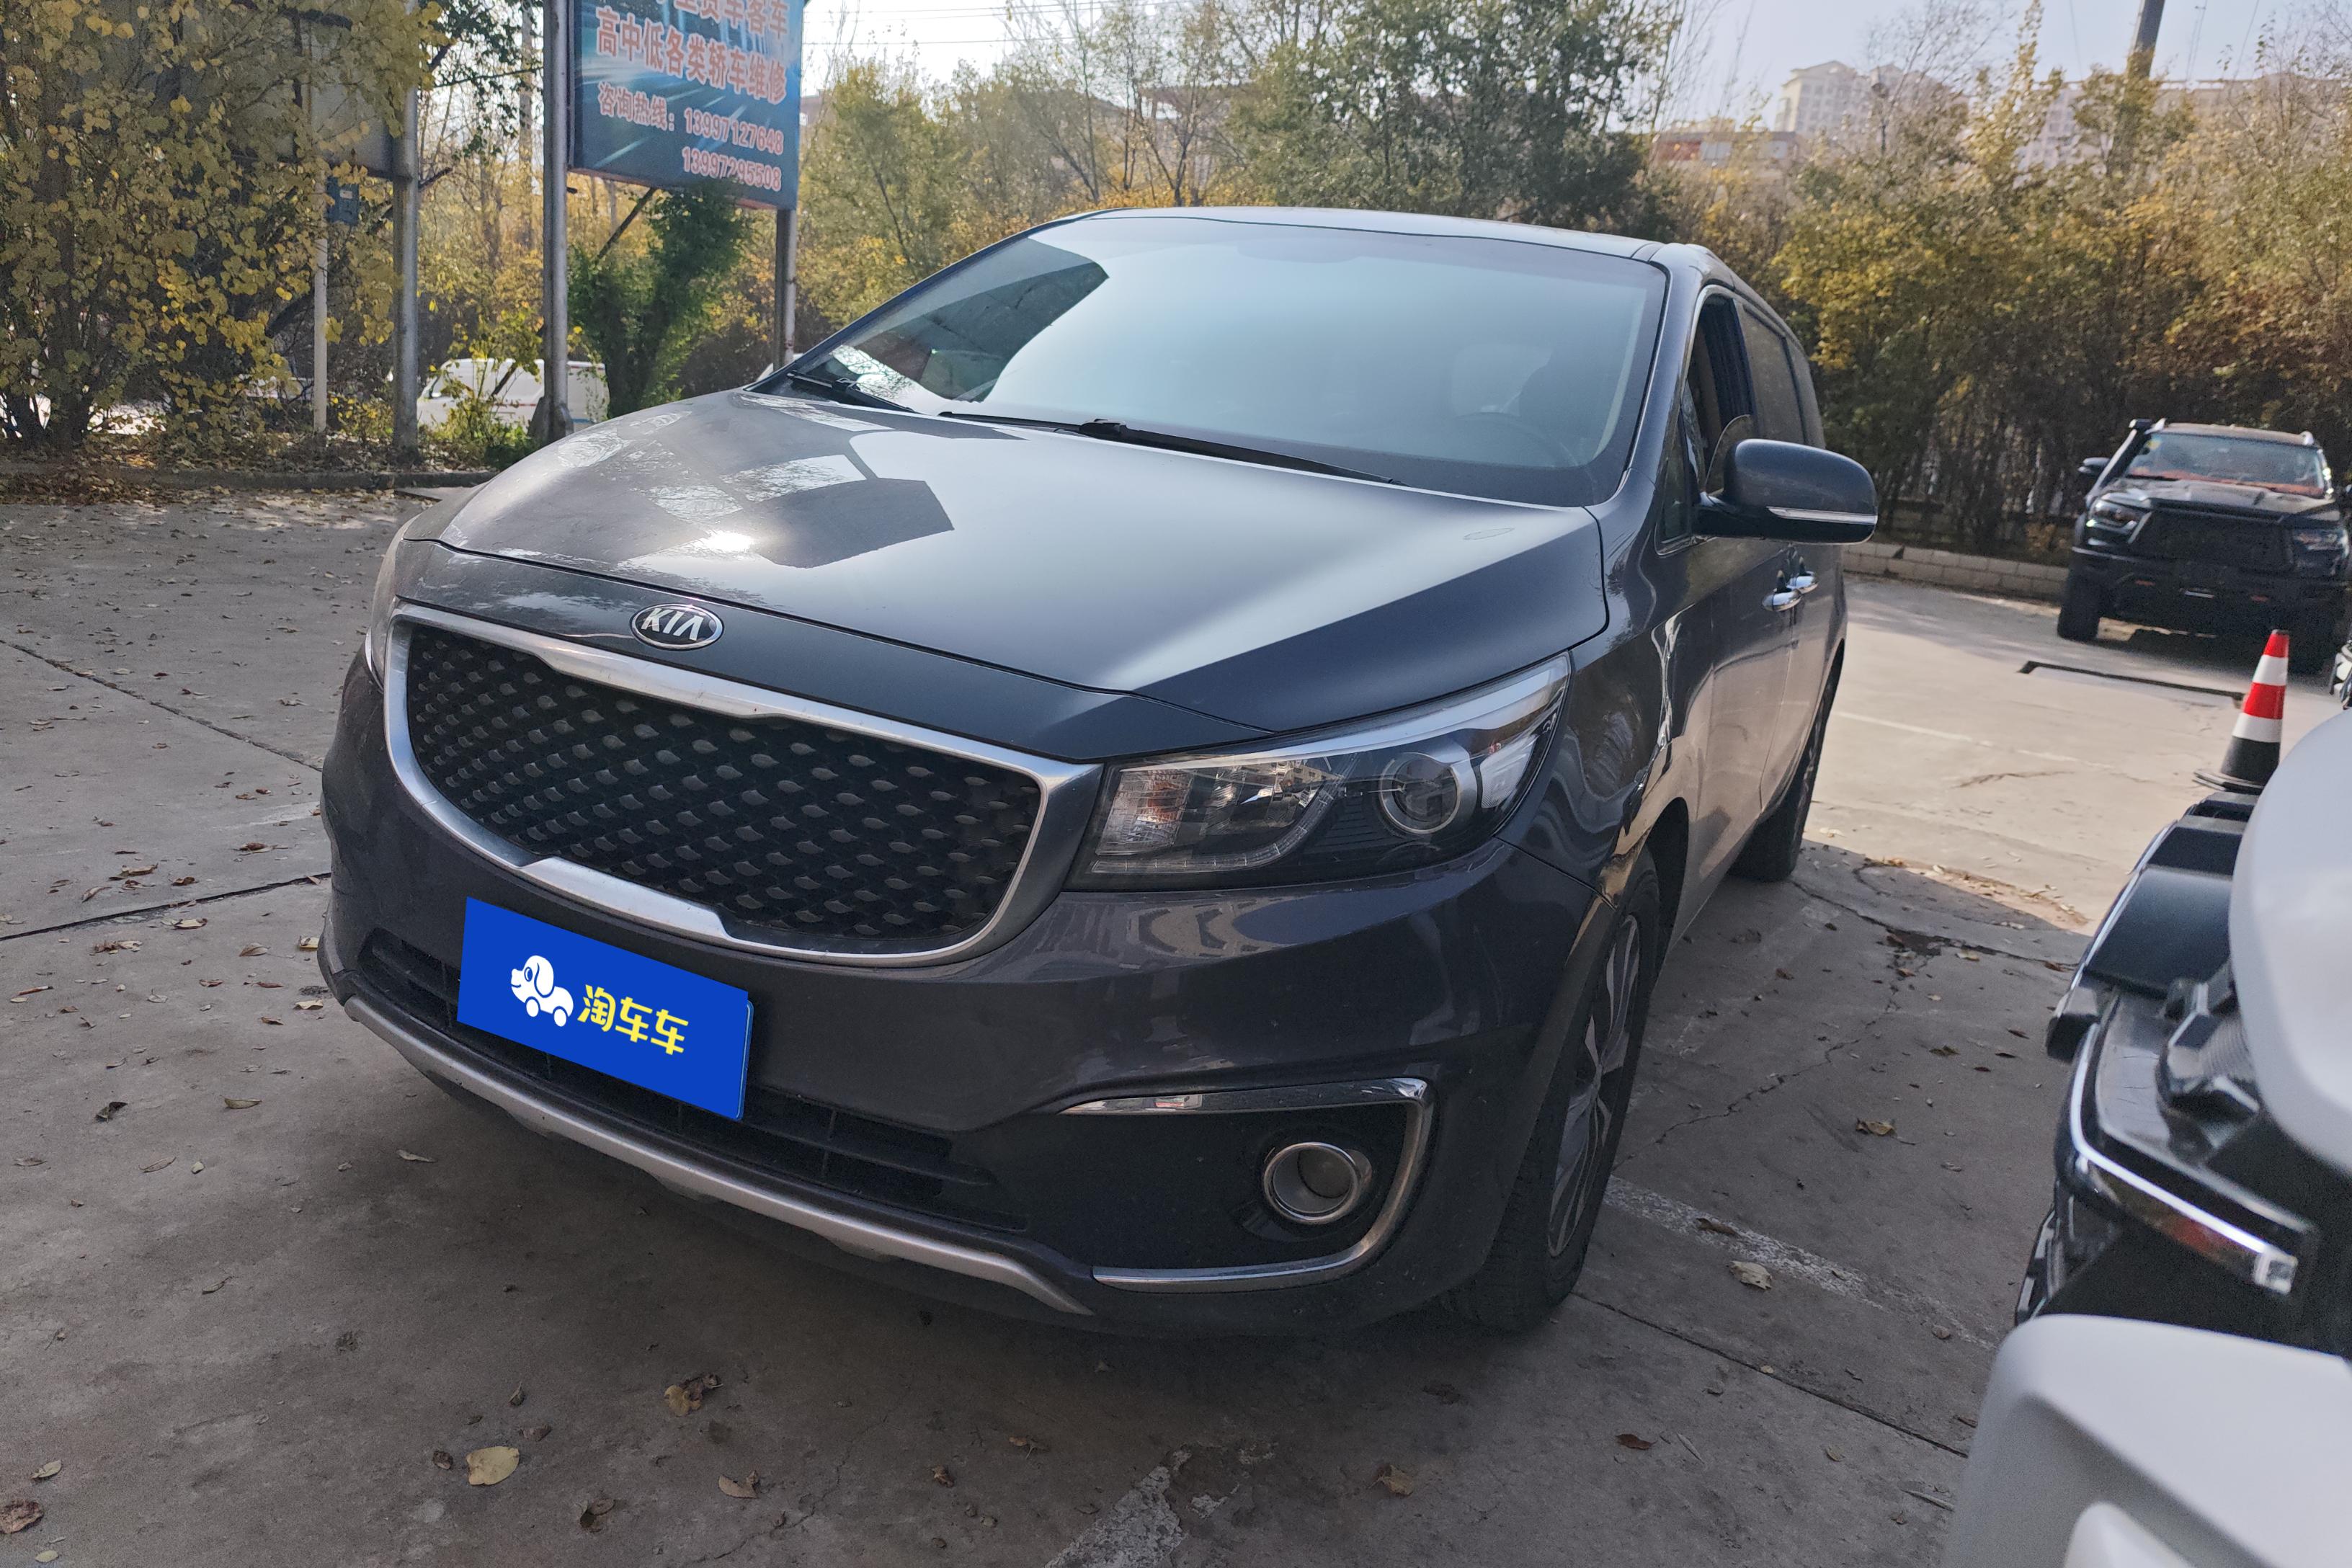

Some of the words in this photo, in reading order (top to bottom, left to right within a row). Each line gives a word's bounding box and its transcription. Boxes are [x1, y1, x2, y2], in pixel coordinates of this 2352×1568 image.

[597, 6, 786, 104] 高中低各类轿车维修
[684, 107, 784, 155] 13997127648
[641, 607, 704, 641] KIA
